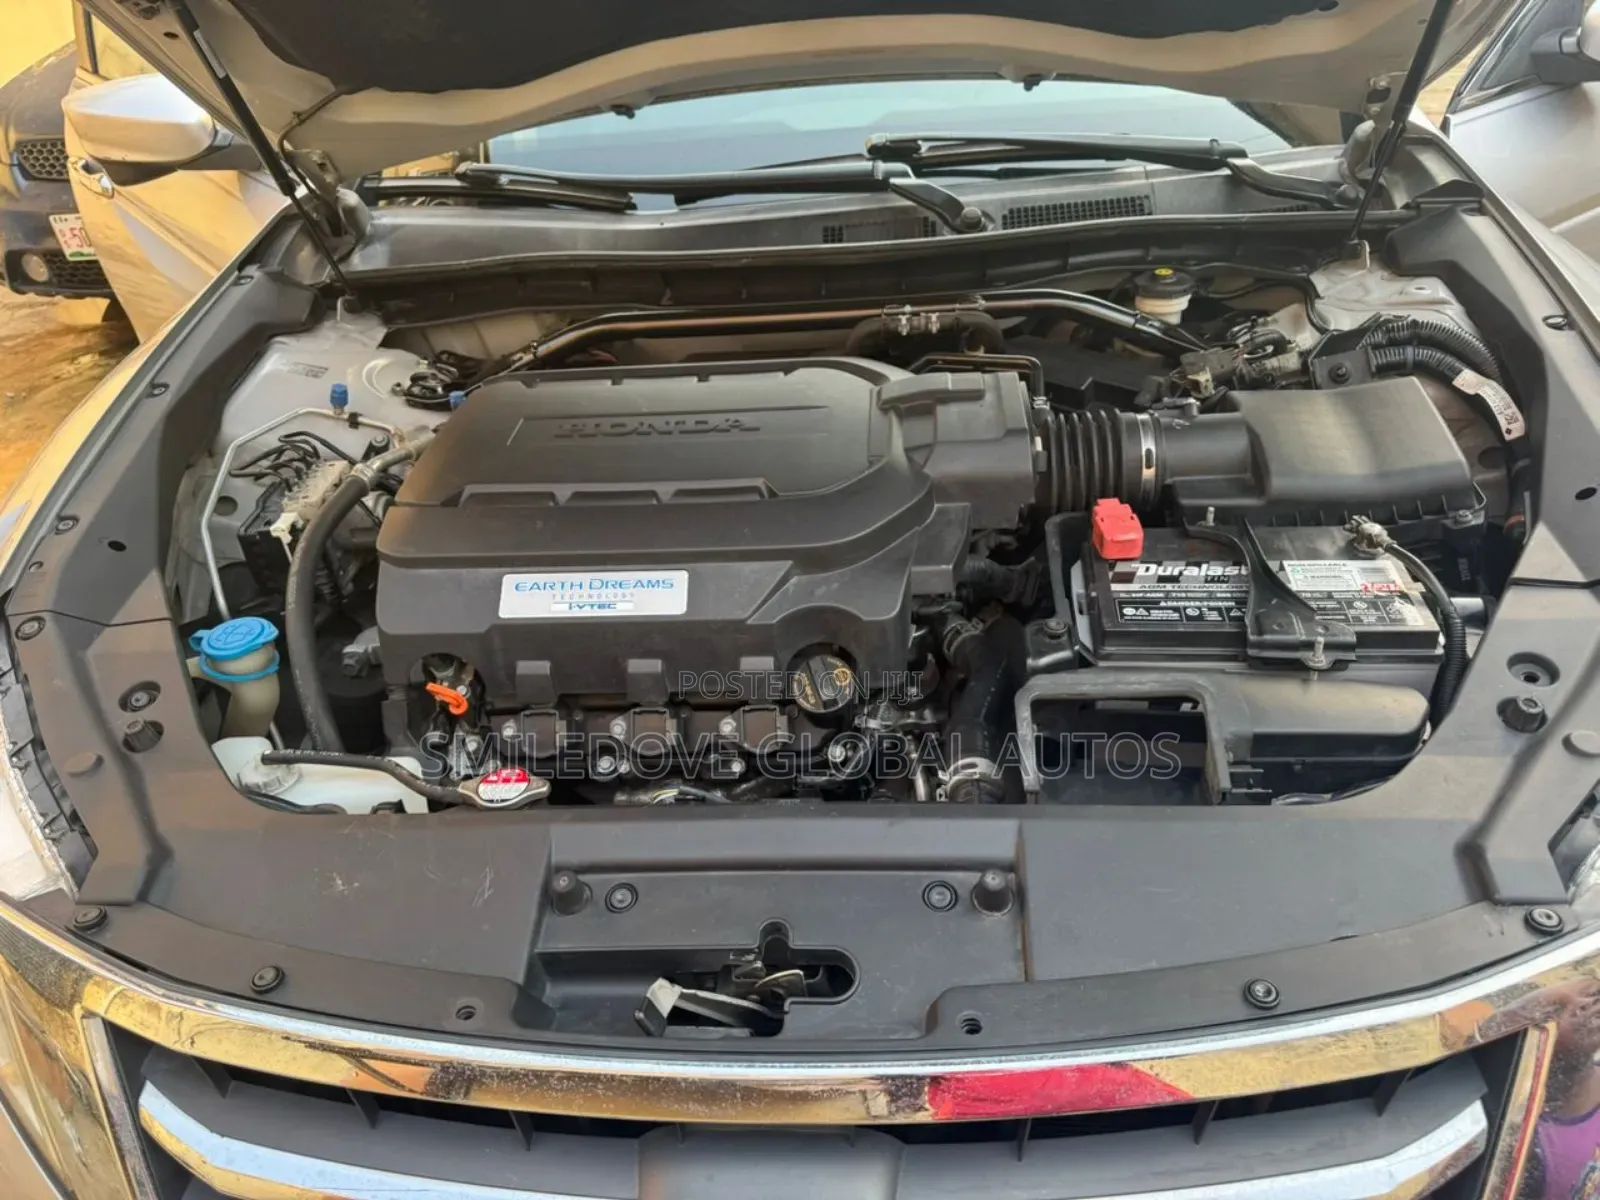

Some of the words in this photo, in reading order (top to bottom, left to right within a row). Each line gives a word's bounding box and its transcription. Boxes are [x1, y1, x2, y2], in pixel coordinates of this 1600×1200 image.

[553, 417, 760, 438] HONDA
[1131, 563, 1249, 576] Duralast
[514, 580, 583, 592] EARTH
[589, 578, 674, 591] DREAMS
